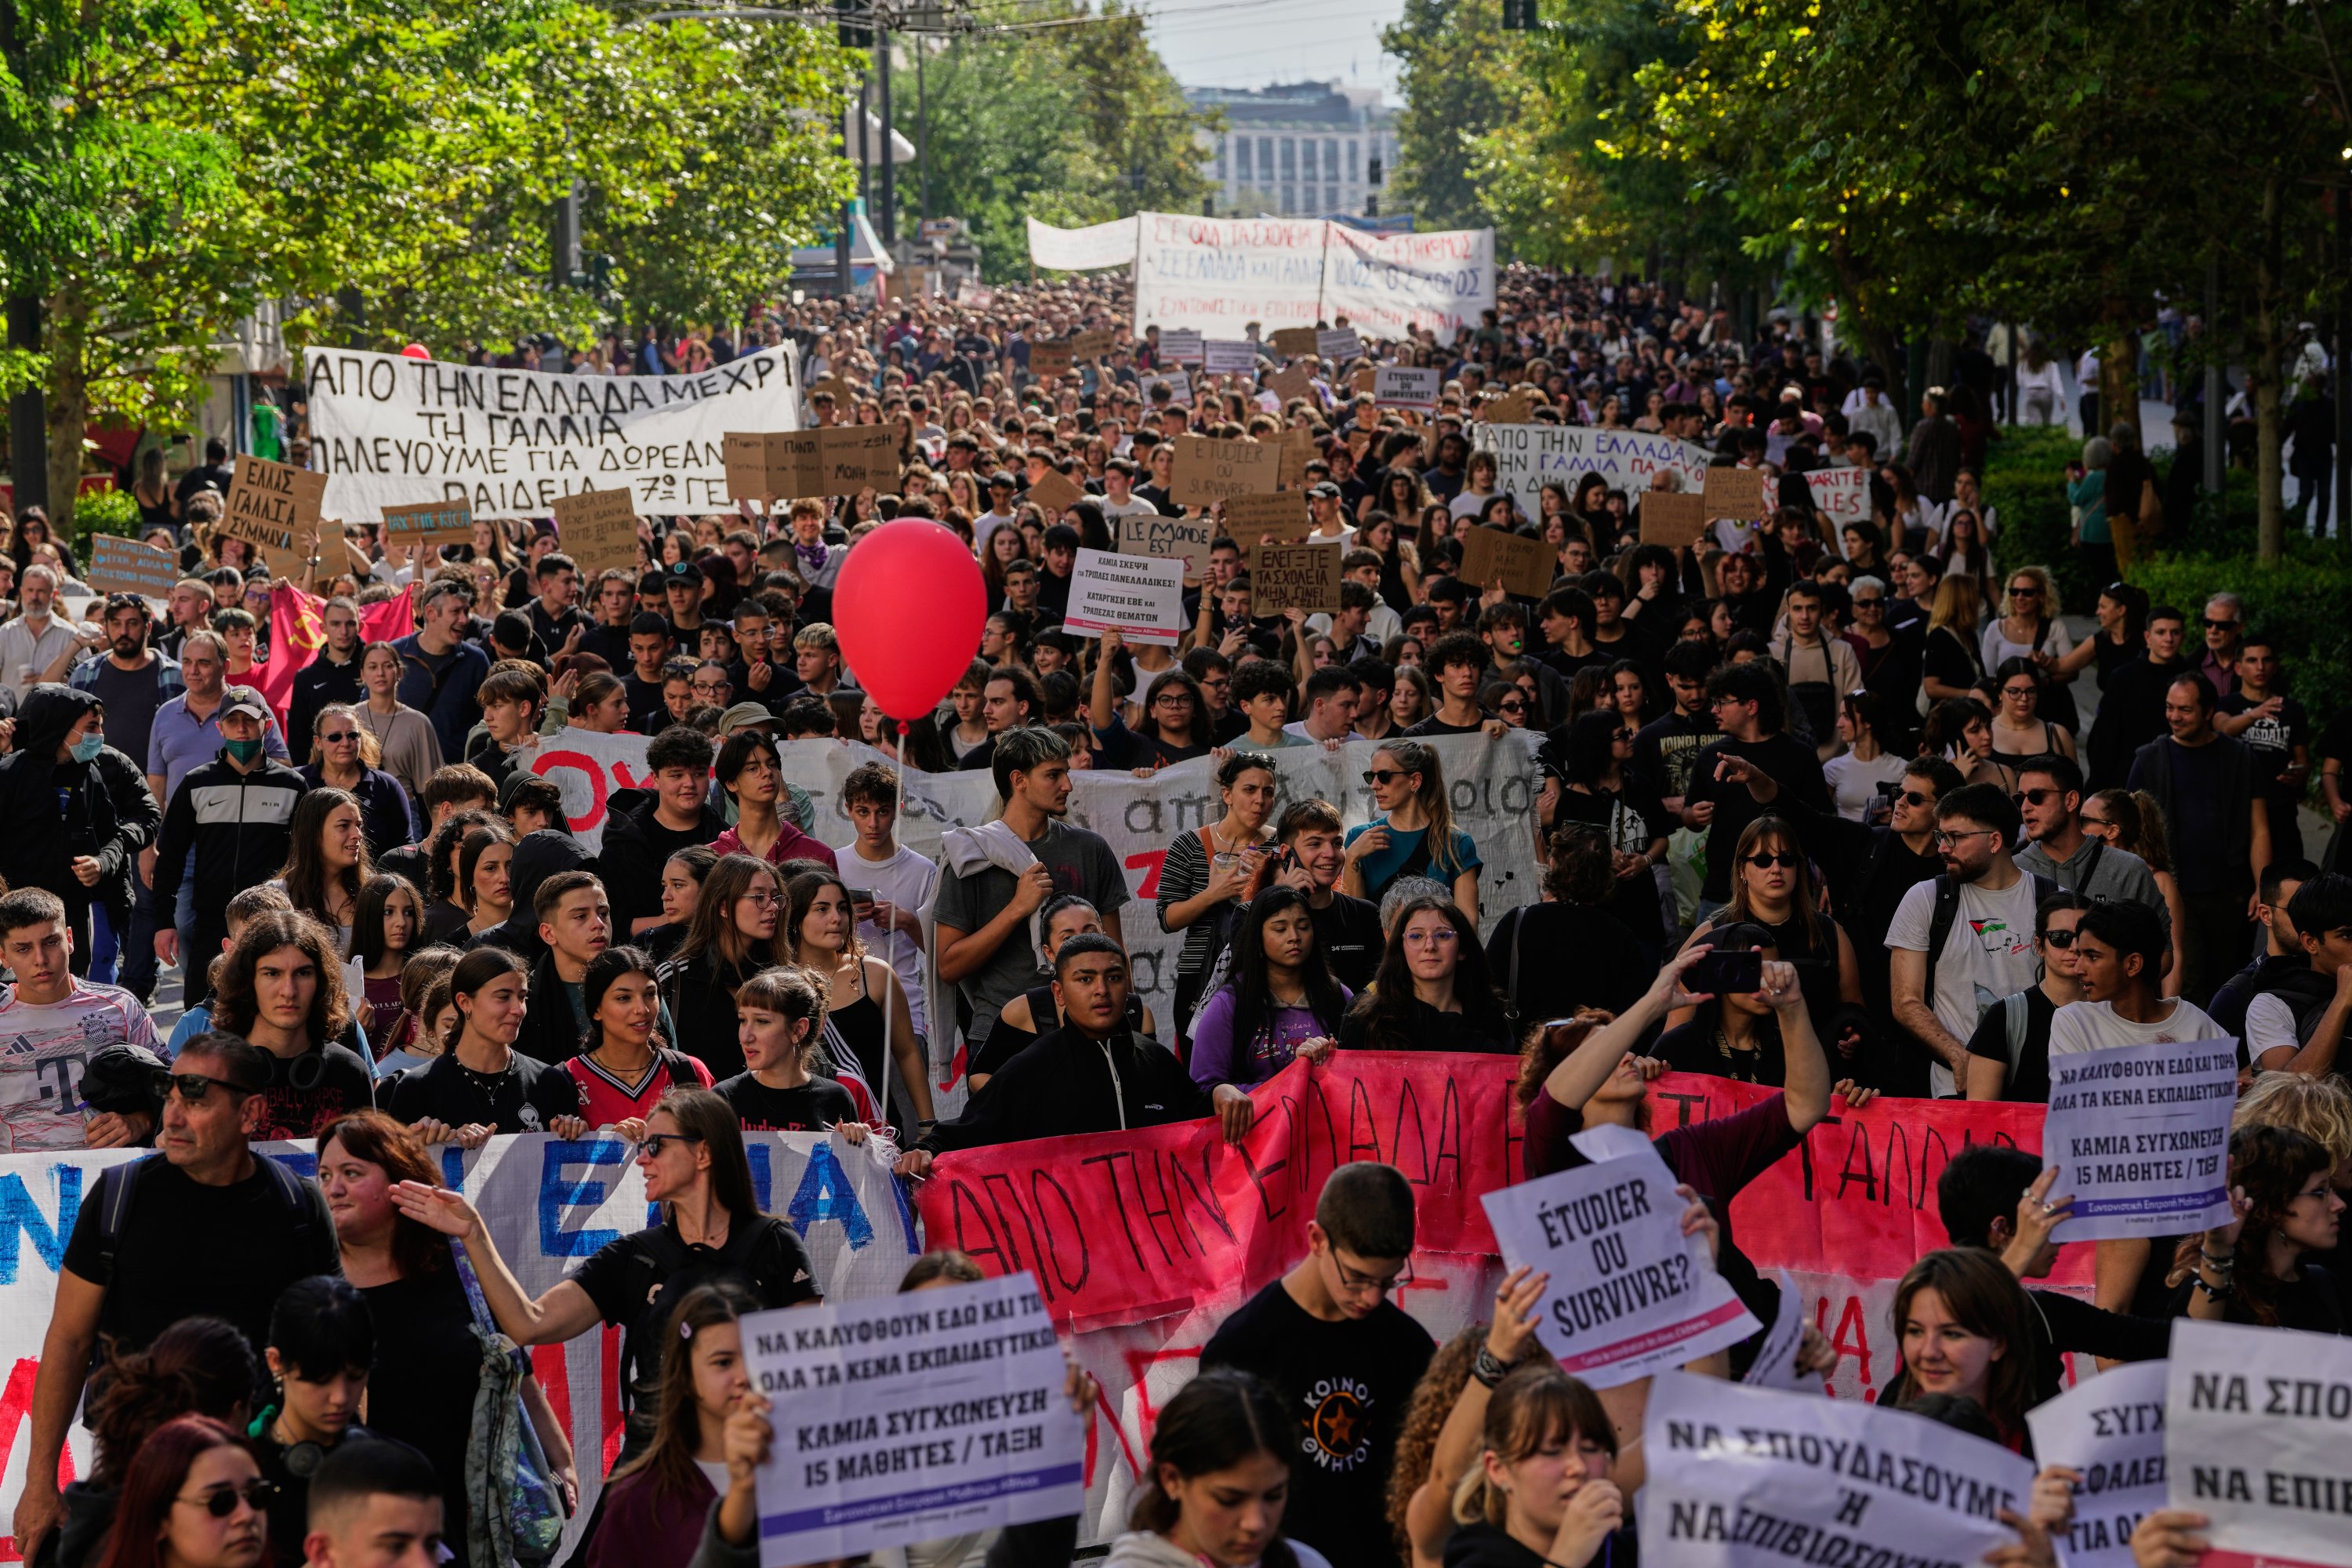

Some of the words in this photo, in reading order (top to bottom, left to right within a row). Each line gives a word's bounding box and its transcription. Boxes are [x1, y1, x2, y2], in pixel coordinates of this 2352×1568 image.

[309, 354, 395, 401] ΑΠΟ
[408, 361, 484, 410] ΤΗΝ
[496, 374, 655, 415] ΕΛΛΑΔΑ
[661, 350, 792, 403] ΜΕΧΡΙ
[416, 412, 466, 445] ΤΗ
[488, 413, 628, 448] ΓΑΛΛΙΑ
[1484, 428, 1528, 451] ΑΠΟ
[1535, 430, 1583, 454] ΤΗΝ
[1595, 432, 1686, 461] ΕΛΛΑΔΑ
[310, 435, 508, 475] ΠΑΛΕΥΟΥΜΕ
[528, 449, 579, 471] ΓΙΑ
[1499, 453, 1527, 471] ΗΝ
[1540, 454, 1619, 474] ΓΑΛΛΙΑ
[246, 461, 296, 495] ΕΛΛΑΣ
[233, 488, 296, 526] ΓΑΛΛΙΑ
[1823, 492, 1862, 515] LES
[1126, 521, 1145, 541] LE
[1148, 522, 1209, 544] MONDE
[1149, 539, 1174, 554] EST
[1085, 569, 1110, 581] ΤΡΙΠΛΕΣ
[1109, 573, 1176, 588] ΠΑΝΕΛΛΑΔΙΚΕΣ!
[1098, 557, 1118, 568] ΚΑΜΙΑ
[1119, 559, 1149, 572] ΣΚΕΨΗ
[1087, 591, 1126, 605] ΚΑΤΑΡΓΗΣΗ
[1127, 597, 1144, 607] ΕΒΕ
[1255, 586, 1288, 600] ΜΗΝ
[1083, 605, 1116, 619] ΤΡΑΠΕΖΑΣ
[1116, 611, 1159, 622] ΘΕΜΑΤΩΝ
[2241, 726, 2291, 746] NSDALE
[2078, 1059, 2165, 1083] ΚΑΛΥΦΘΟΥΝ
[2194, 1055, 2212, 1072] ΚΑΙ
[2052, 1094, 2077, 1112] ΟΛΑ
[2081, 1091, 2099, 1109] ΤΑ
[2101, 1088, 2144, 1107] ΚΕΝΑ
[2071, 1135, 2132, 1158] ΚΑΜΙΑ
[2136, 1127, 2224, 1154] ΣΥΓΧΩΝΕΥΣΗ
[2076, 1166, 2092, 1185] 15
[2096, 1159, 2183, 1185] ΜΑΘΗΤΕΣ
[2187, 1157, 2194, 1179] /
[950, 1168, 1090, 1303] ΑΠΟ
[1080, 1140, 1239, 1272] ΤΗΝ
[1239, 1075, 1463, 1223] ΕΛΛΑΔΑ
[1536, 1178, 1652, 1250] ÉTUDIER
[1590, 1232, 1628, 1276] OU
[1552, 1253, 1690, 1338] SURVIVRE?
[757, 1333, 789, 1357] ΝΑ
[793, 1310, 931, 1352] ΚΑΛΥΦΘΟΥΝ
[982, 1298, 1015, 1324] ΚΑΙ
[760, 1374, 807, 1392] ΟΛΑ
[812, 1367, 841, 1387] ΤΑ
[845, 1356, 902, 1384] ΚΕΝΑ
[1303, 1376, 1375, 1410] ΚΟΙΝΟΙ
[2190, 1371, 2252, 1414] ΝΑ
[797, 1415, 880, 1452] ΚΑΜΙΑ
[887, 1387, 1050, 1436] ΣΥΓΧΩΝΕΥΣΗ
[2091, 1401, 2165, 1437] ΣΥΓΧ
[804, 1460, 828, 1489] 15
[837, 1440, 956, 1483] ΜΑΘΗΤΕΣ
[962, 1434, 975, 1464] /
[979, 1425, 1044, 1461] ΤΑΞΗ
[1301, 1437, 1371, 1472] ΘΝΗΤΟΙ
[1665, 1419, 1722, 1450] ΝΑ
[1737, 1427, 2017, 1522] ΣΠΟΥΔΑΣΟΥΜΕ
[2190, 1465, 2252, 1503] ΝΑ
[1668, 1501, 1727, 1542] ΝΑ
